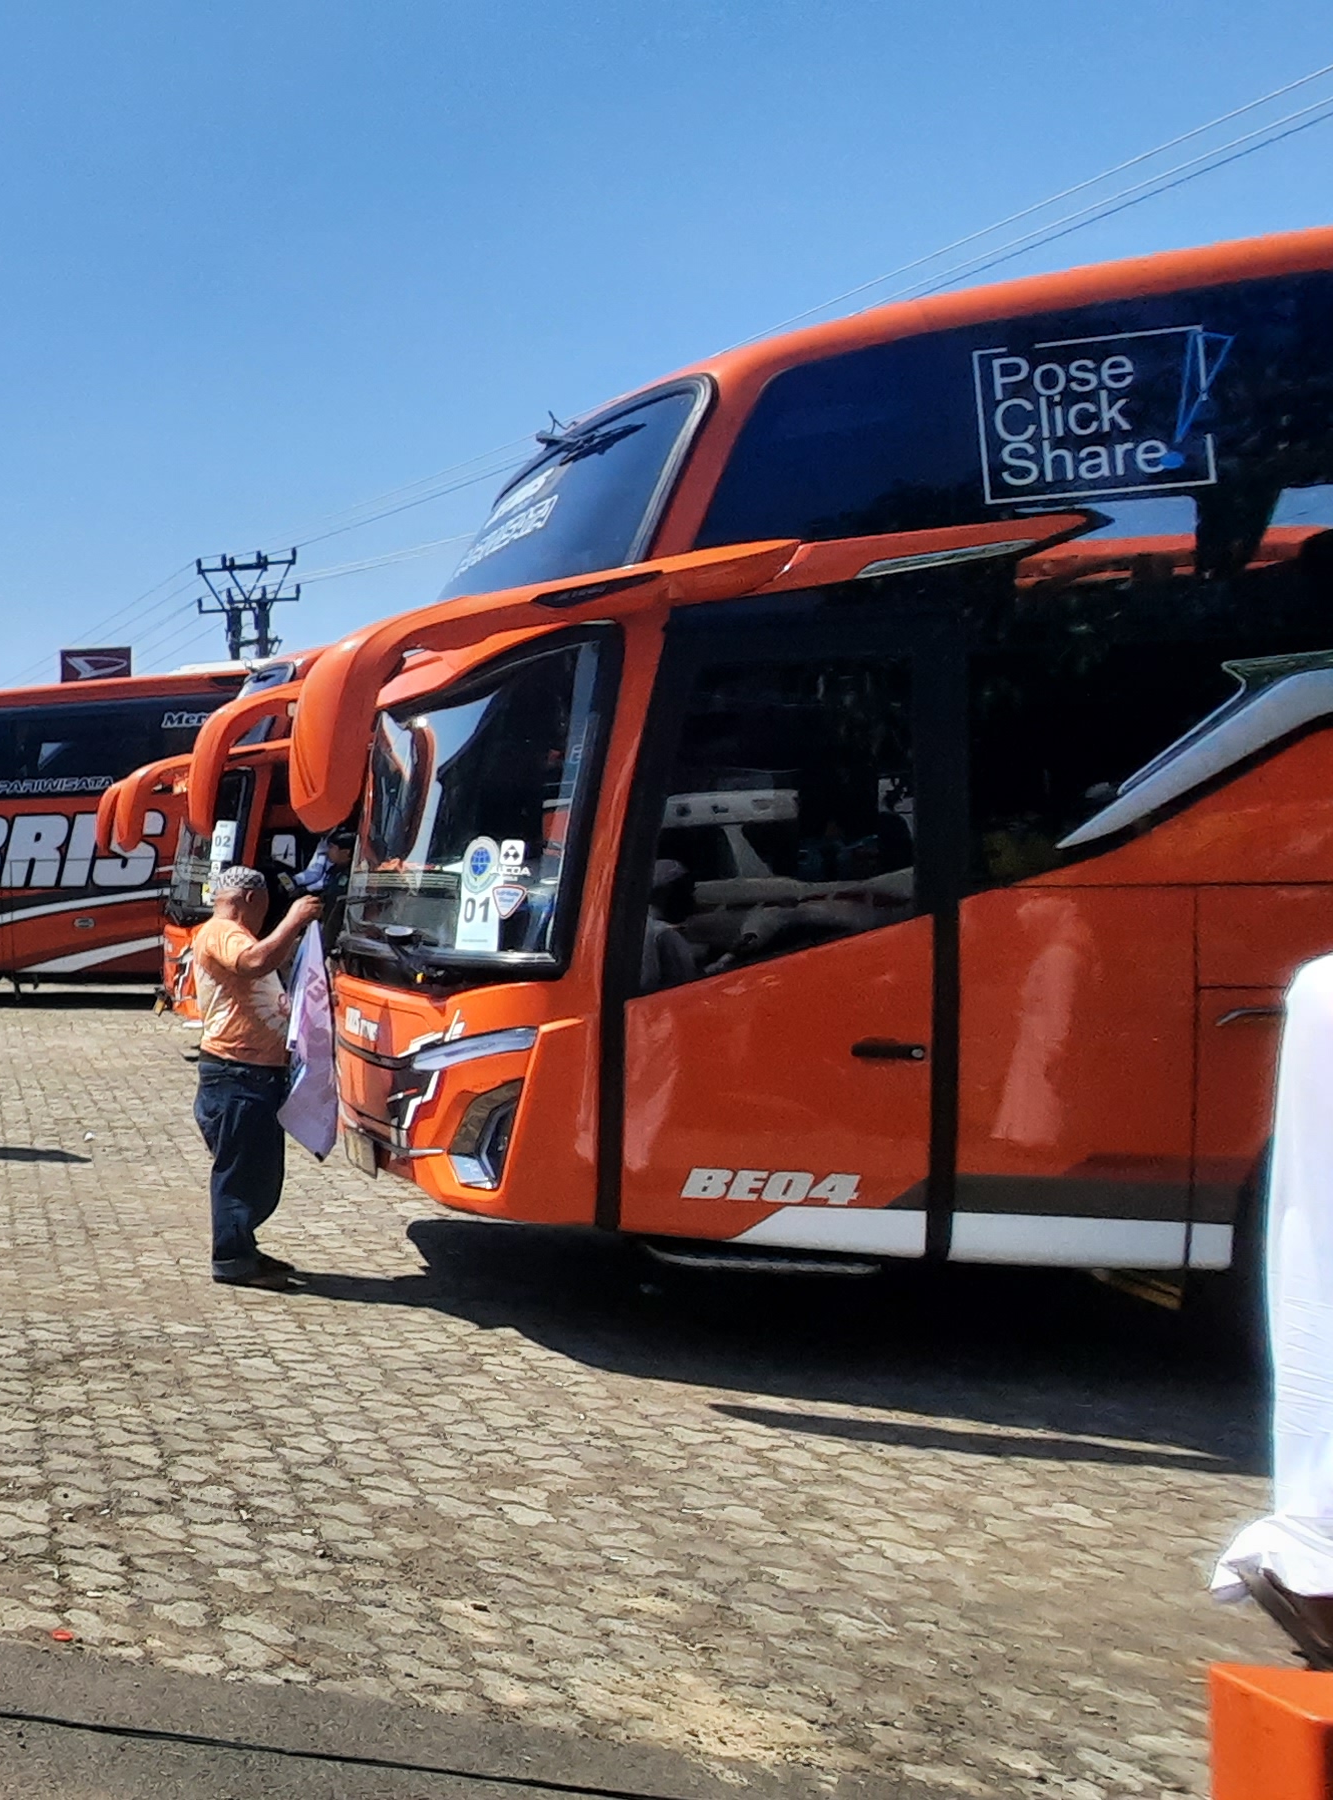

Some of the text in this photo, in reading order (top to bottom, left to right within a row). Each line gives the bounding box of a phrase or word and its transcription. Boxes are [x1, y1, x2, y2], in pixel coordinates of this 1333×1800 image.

[991, 355, 1134, 400] Pose
[994, 389, 1133, 442] Click
[1001, 437, 1168, 486] Share
[214, 835, 231, 848] 02
[463, 896, 491, 923] 01
[680, 1167, 862, 1205] BE04
